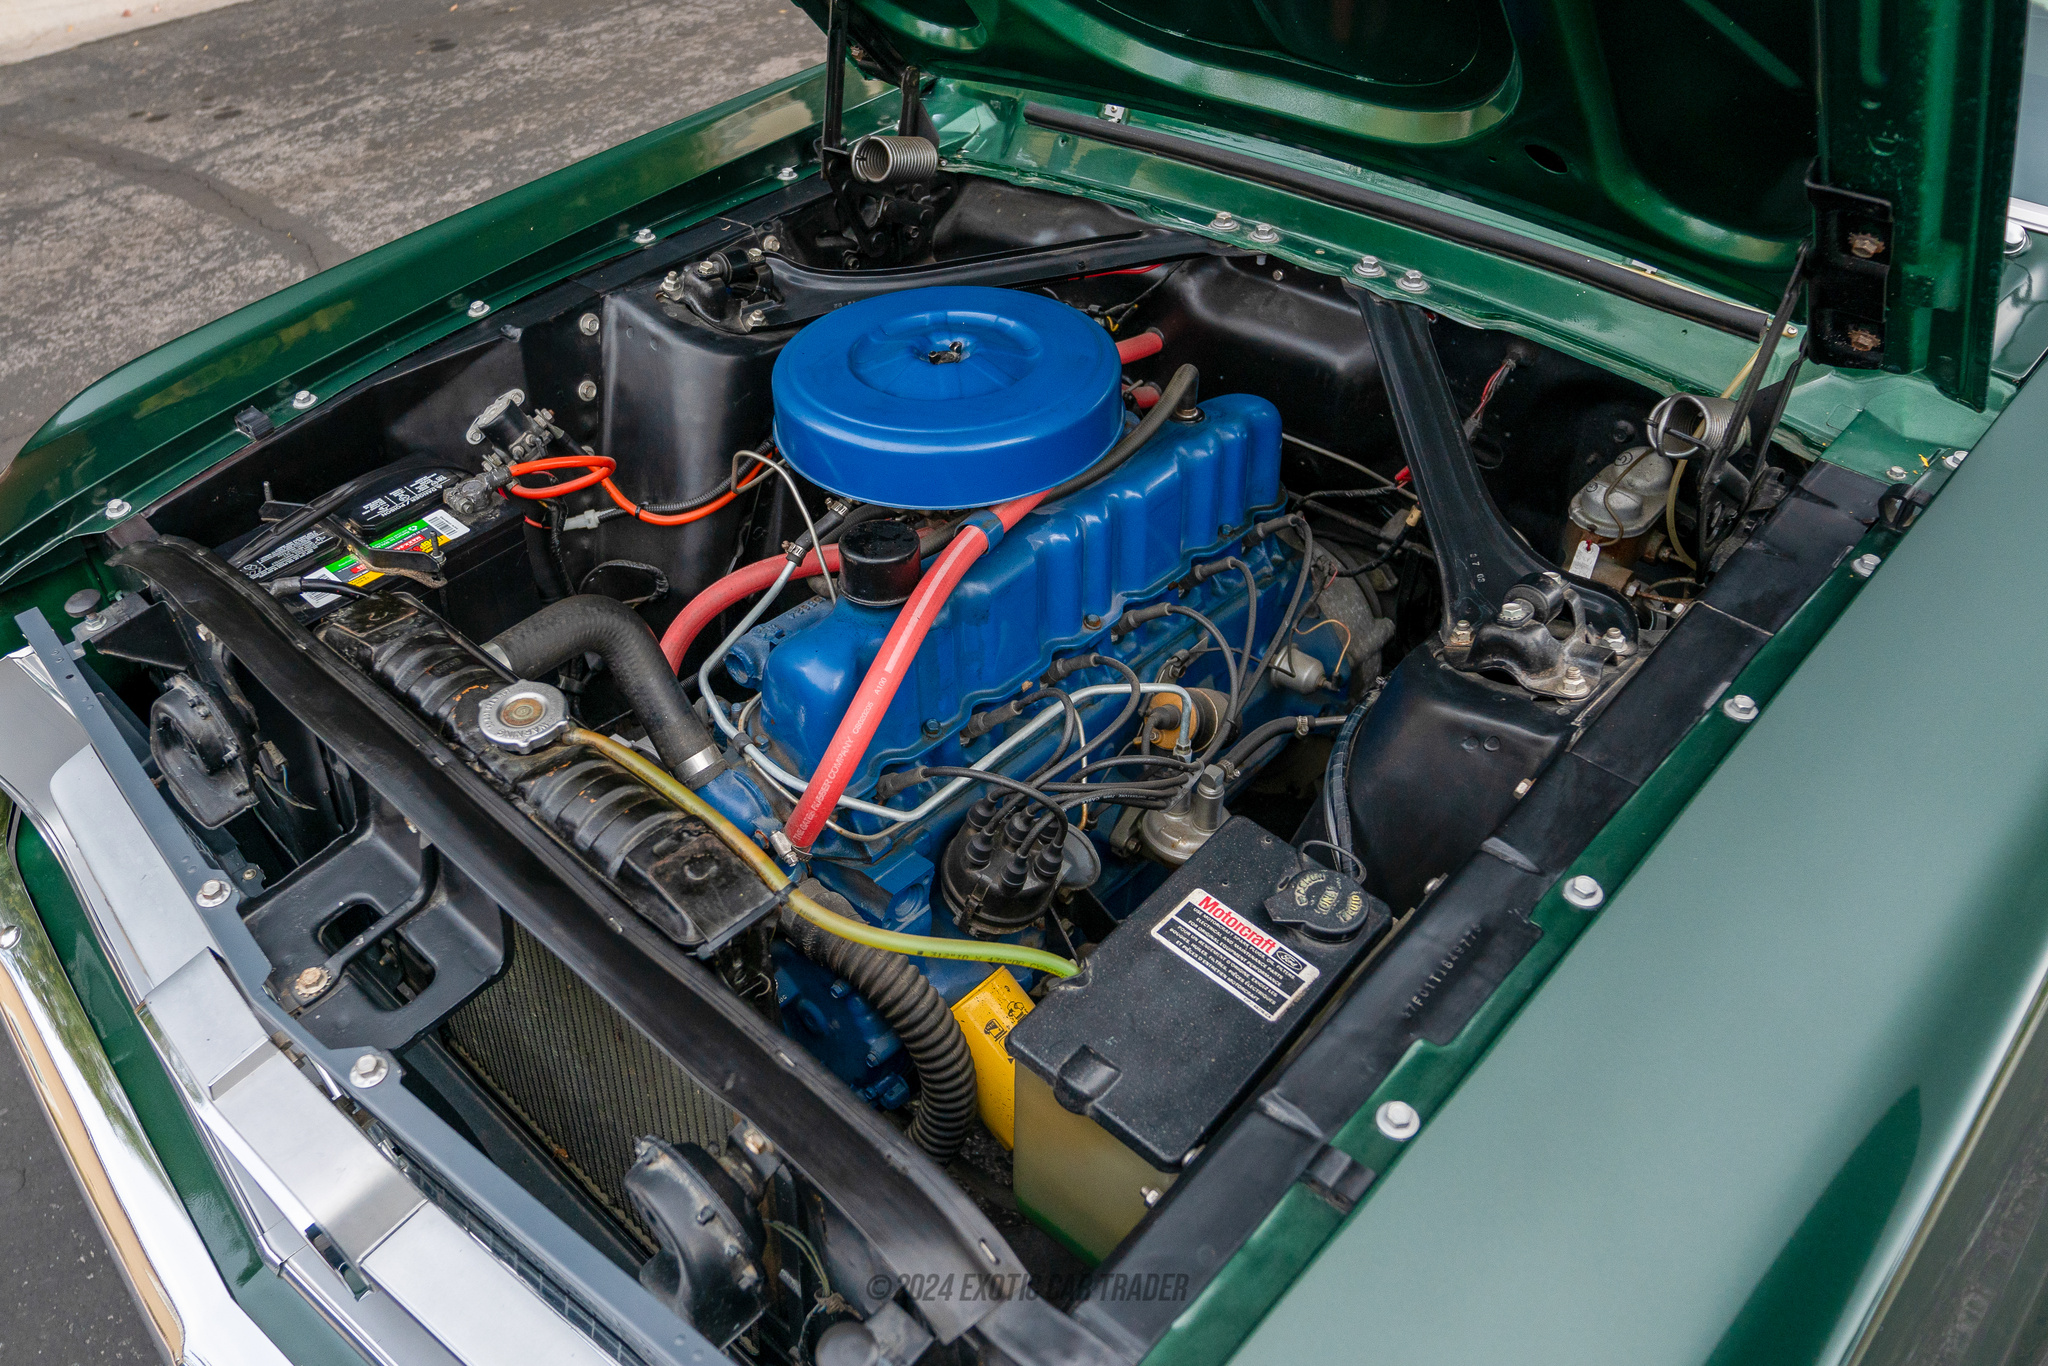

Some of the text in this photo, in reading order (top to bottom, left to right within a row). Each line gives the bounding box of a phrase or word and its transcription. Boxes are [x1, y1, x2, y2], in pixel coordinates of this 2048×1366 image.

[810, 779, 833, 811] RUBBER
[829, 736, 854, 780] COMPANY
[874, 676, 888, 696] A100
[1176, 924, 1192, 937] POUR
[1189, 933, 1199, 942] UN
[1196, 939, 1227, 961] RENDEMENT
[1266, 988, 1278, 998] LES
[1187, 919, 1282, 987] FOR ORIGINAL EQUIPMENT PERFORMANCE
[1191, 906, 1203, 915] USE
[1201, 913, 1234, 937] MOTORCRAFT
[1232, 934, 1250, 948] SPARK
[1194, 916, 1284, 980] ELECTRICAL AND MAINTENANCE PARTS
[1197, 894, 1299, 968] Motorcraft Ford
[1225, 975, 1260, 1002] MOTORCRAFT
